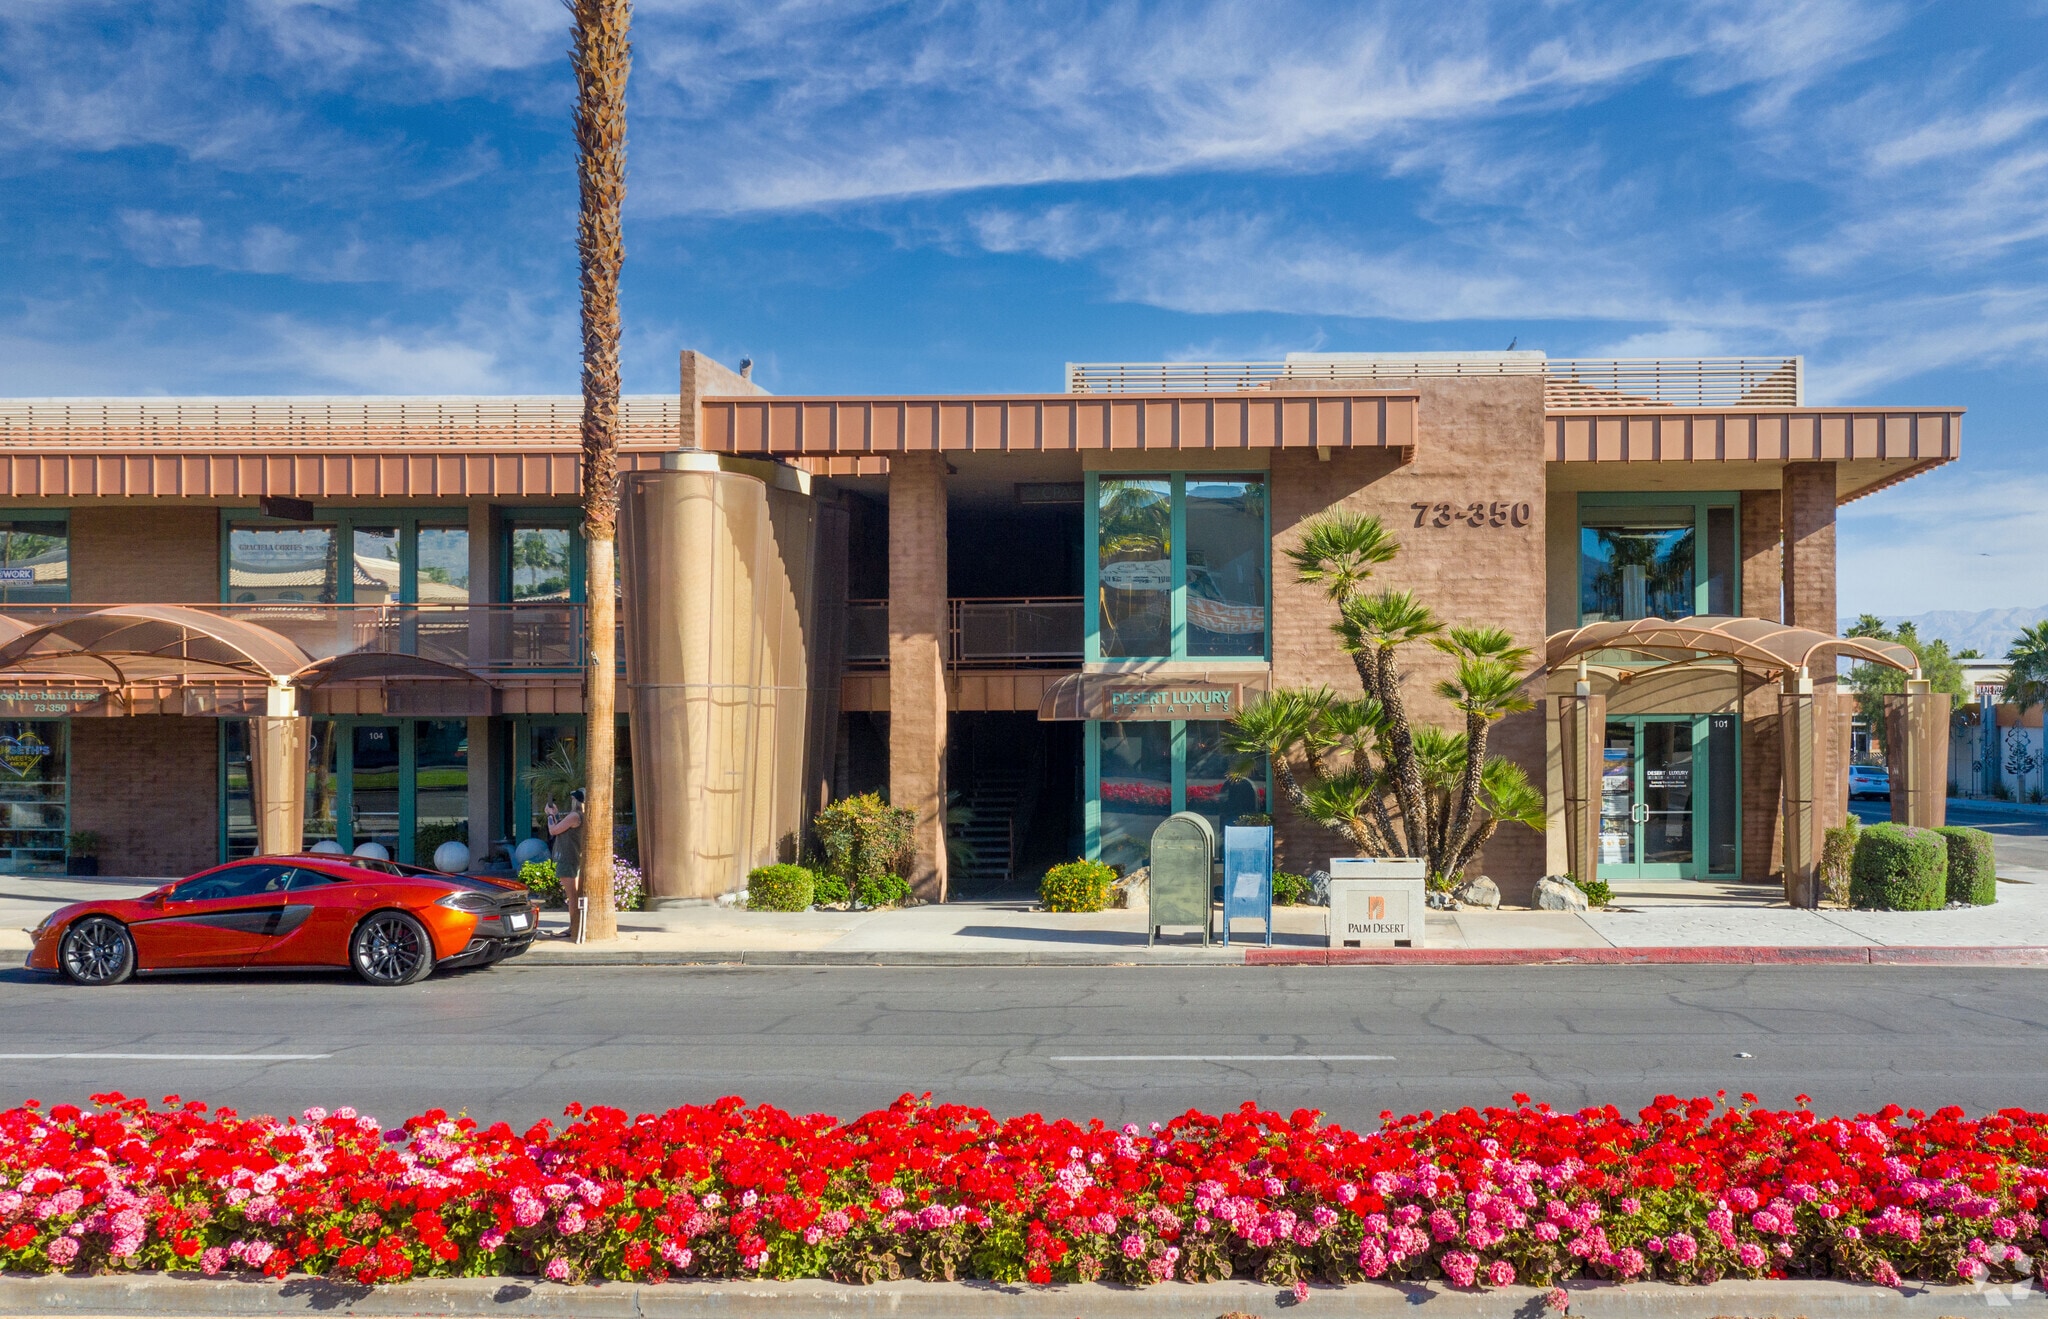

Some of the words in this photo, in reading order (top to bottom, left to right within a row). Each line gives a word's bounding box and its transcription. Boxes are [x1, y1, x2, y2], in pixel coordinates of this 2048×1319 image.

[1410, 501, 1534, 528] 73-350
[0, 570, 31, 579] WORK
[1112, 691, 1168, 705] DESERT
[1172, 690, 1232, 704] LUXURY
[34, 703, 67, 712] 73-350
[1113, 703, 1230, 714] ESTATES
[1714, 720, 1728, 728] 101
[369, 732, 384, 740] 104
[1348, 923, 1371, 933] PALM
[1373, 923, 1405, 933] DESERT
